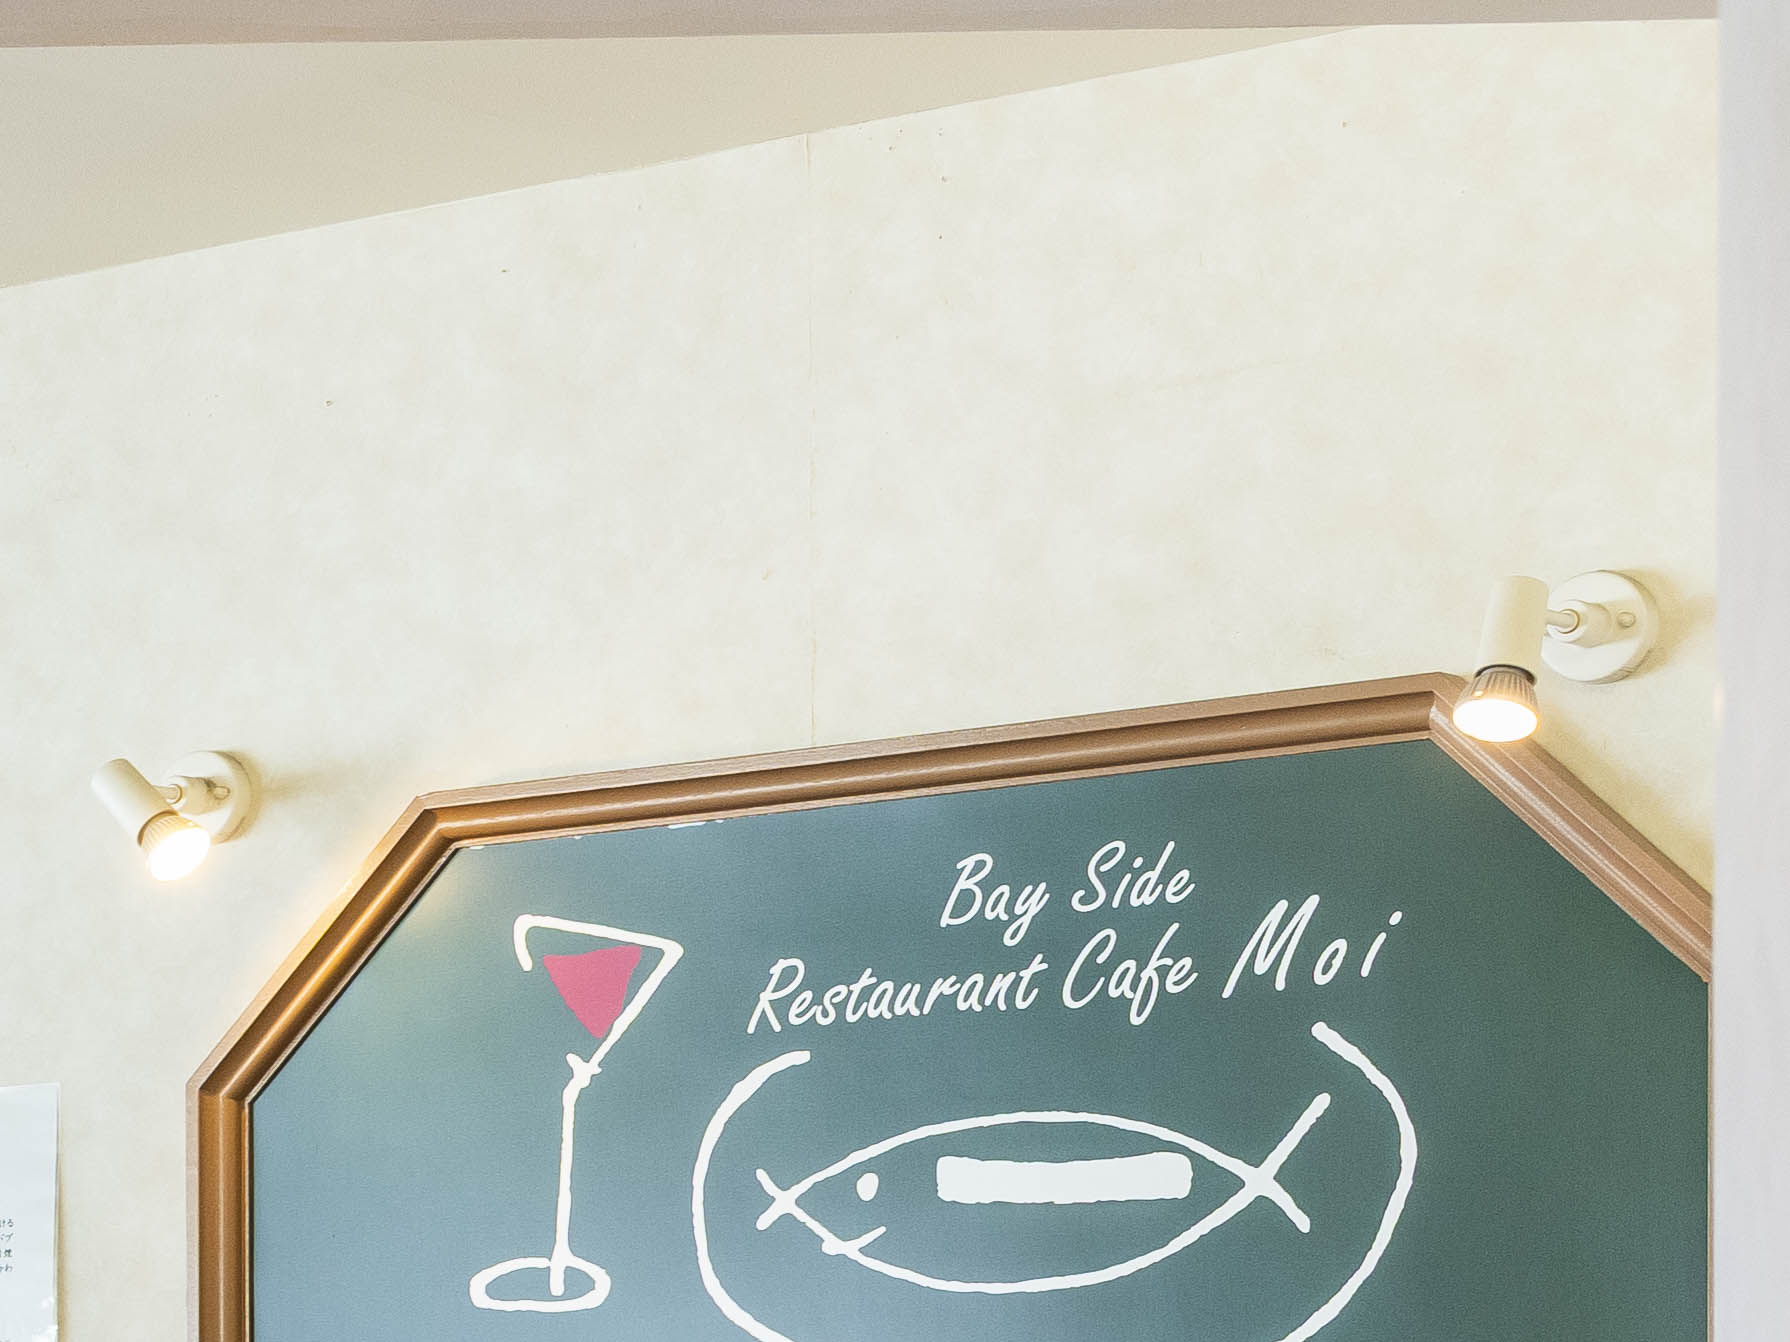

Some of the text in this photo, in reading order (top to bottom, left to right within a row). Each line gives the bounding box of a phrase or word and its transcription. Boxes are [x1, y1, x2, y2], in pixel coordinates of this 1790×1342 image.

[940, 838, 1195, 945] Bay Side
[746, 891, 1403, 1037] Restaurant Cafe Moi
